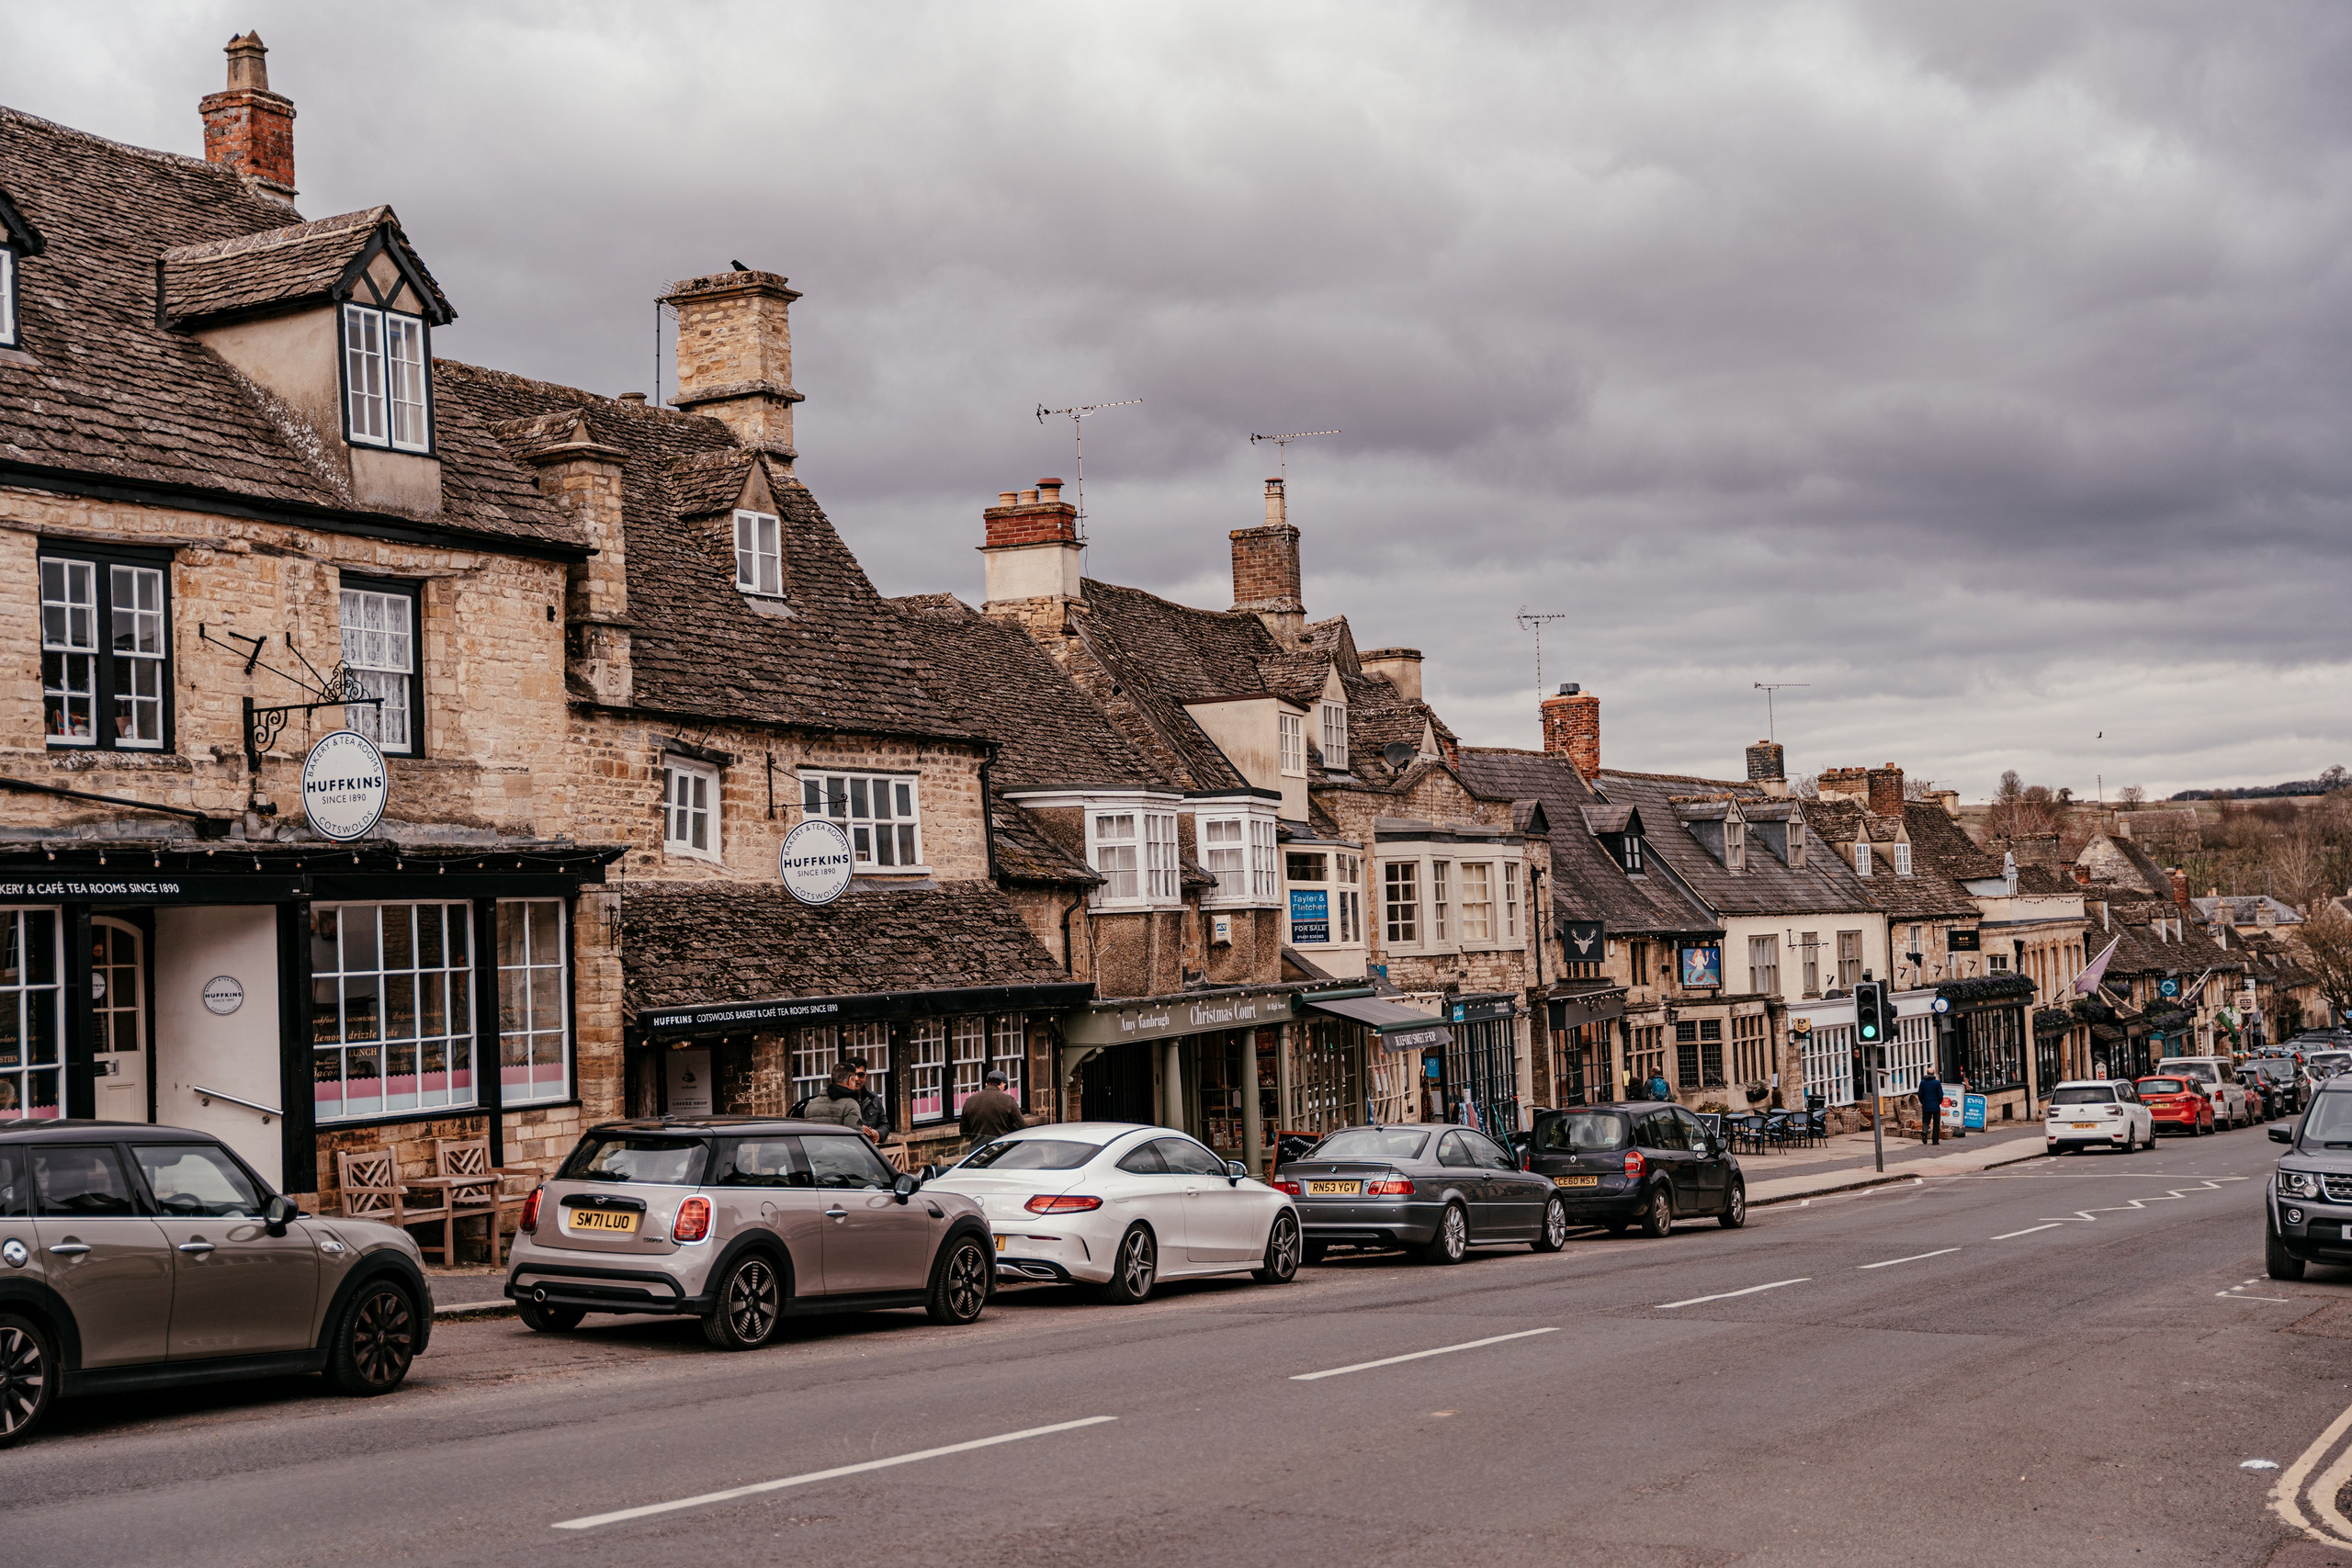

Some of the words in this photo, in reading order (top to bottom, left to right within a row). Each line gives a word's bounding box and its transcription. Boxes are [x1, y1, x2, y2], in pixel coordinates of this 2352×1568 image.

[307, 742, 330, 777] BAKERY
[333, 739, 338, 747] &
[340, 736, 355, 746] TEA
[357, 741, 379, 772] ROOMS
[307, 776, 382, 793] HUFFKINS
[322, 795, 346, 804] SINCE
[349, 793, 366, 802] 1890
[319, 810, 373, 834] COTSWOLDS
[785, 829, 803, 856] BAKERY
[827, 828, 847, 852] ROOMS
[785, 854, 849, 868] HUFFKINS
[27, 884, 35, 894] &
[37, 882, 65, 894] CAFÉ
[67, 883, 88, 893] TEA
[89, 883, 127, 893] ROOMS
[129, 883, 158, 893] SINCE
[159, 883, 180, 893] 1890
[796, 881, 842, 900] COTSWOLDS
[1292, 895, 1317, 904] Tayler
[653, 1015, 692, 1026] HUFFKINS
[697, 1013, 734, 1023] COTSWOLDS
[735, 1010, 757, 1019] BAKERY
[762, 1007, 776, 1017] CAFÉ
[777, 1008, 789, 1016] TEA
[790, 1006, 809, 1015] ROOMS
[810, 1005, 826, 1014] SINCE
[827, 1004, 838, 1012] 1890
[1121, 1018, 1136, 1036] Amy
[1137, 1012, 1170, 1030] Vanbrugh
[1190, 1005, 1233, 1026] Christmas
[1234, 1001, 1256, 1020] Court
[314, 1033, 340, 1042] Lemon
[348, 1029, 377, 1040] drizzle
[348, 1048, 377, 1057] LUNCH
[1313, 1183, 1336, 1192] RN53
[1339, 1183, 1356, 1192] YGV
[577, 1213, 604, 1227] SM71
[605, 1214, 629, 1229] LUO
